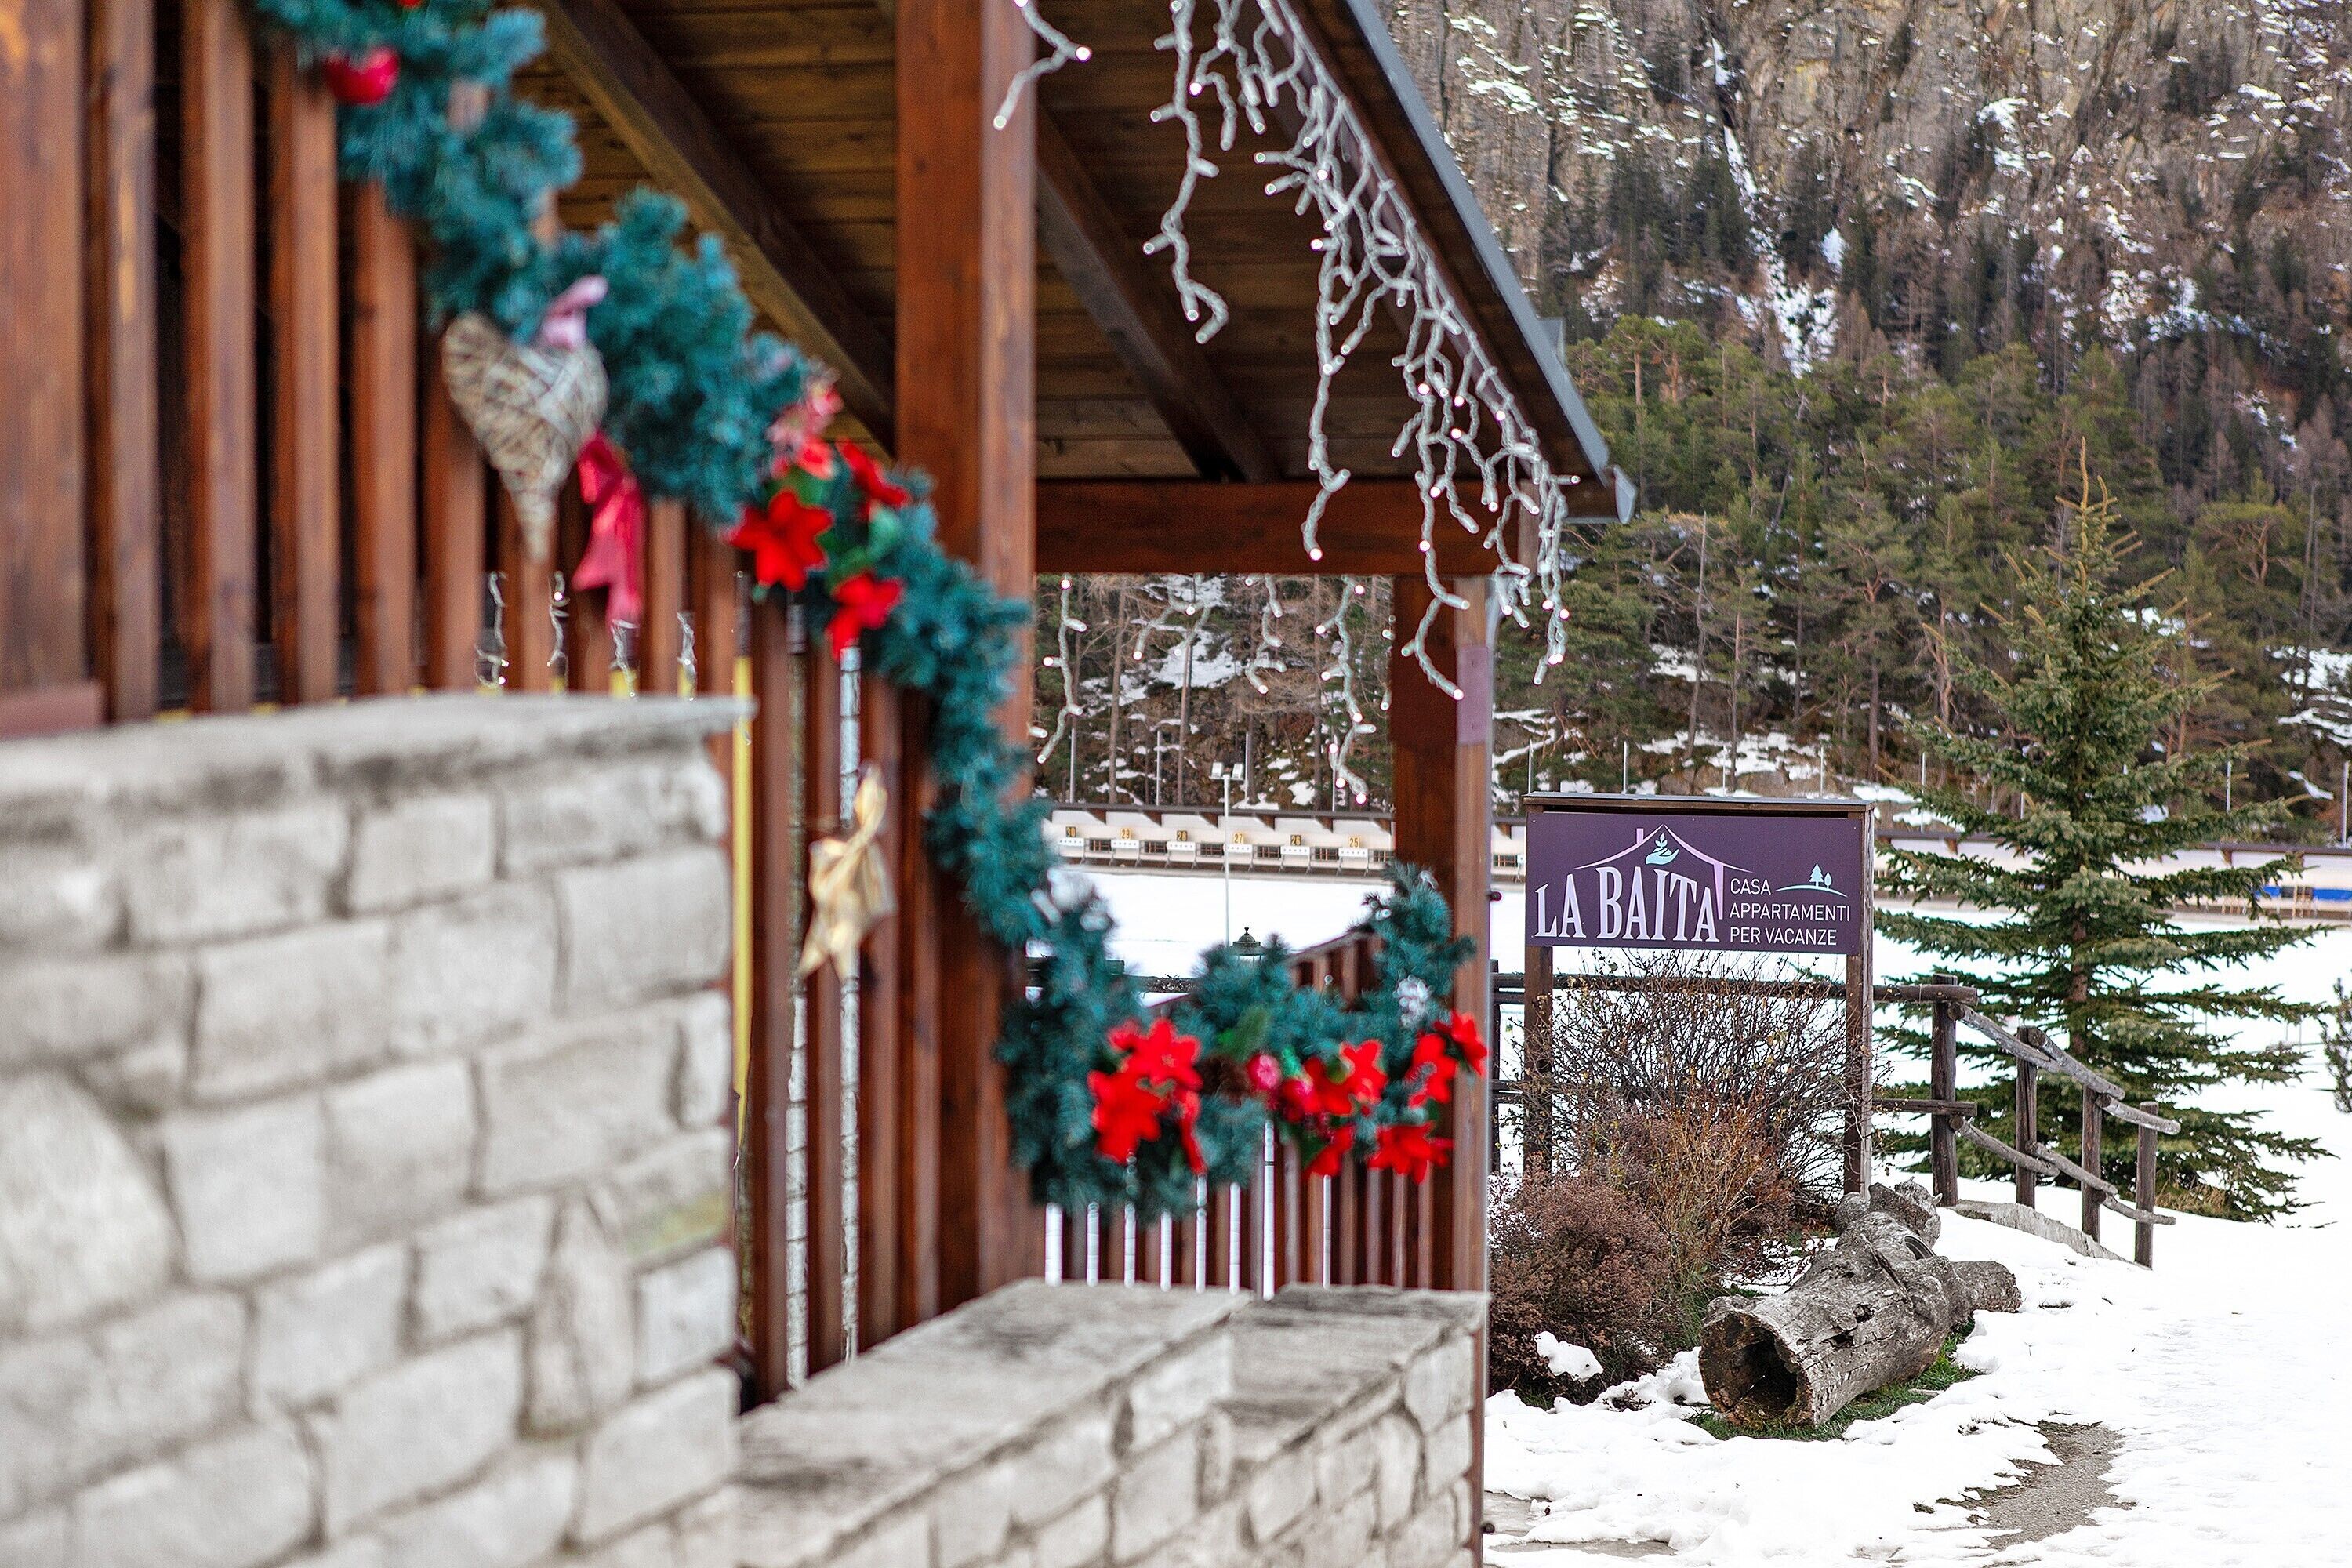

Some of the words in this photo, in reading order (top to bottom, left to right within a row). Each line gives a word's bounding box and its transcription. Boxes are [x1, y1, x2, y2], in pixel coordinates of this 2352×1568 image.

[1066, 827, 1076, 837] 30
[1121, 829, 1131, 839] 29
[1234, 833, 1243, 843] 27
[1349, 837, 1359, 848] 25
[1730, 878, 1772, 895] CASA
[1534, 873, 1587, 938] LA
[1595, 866, 1720, 942] BAITA
[1729, 903, 1851, 922] APPARTAMENTI
[1730, 927, 1761, 944] PER
[1764, 928, 1838, 946] VACANZE
